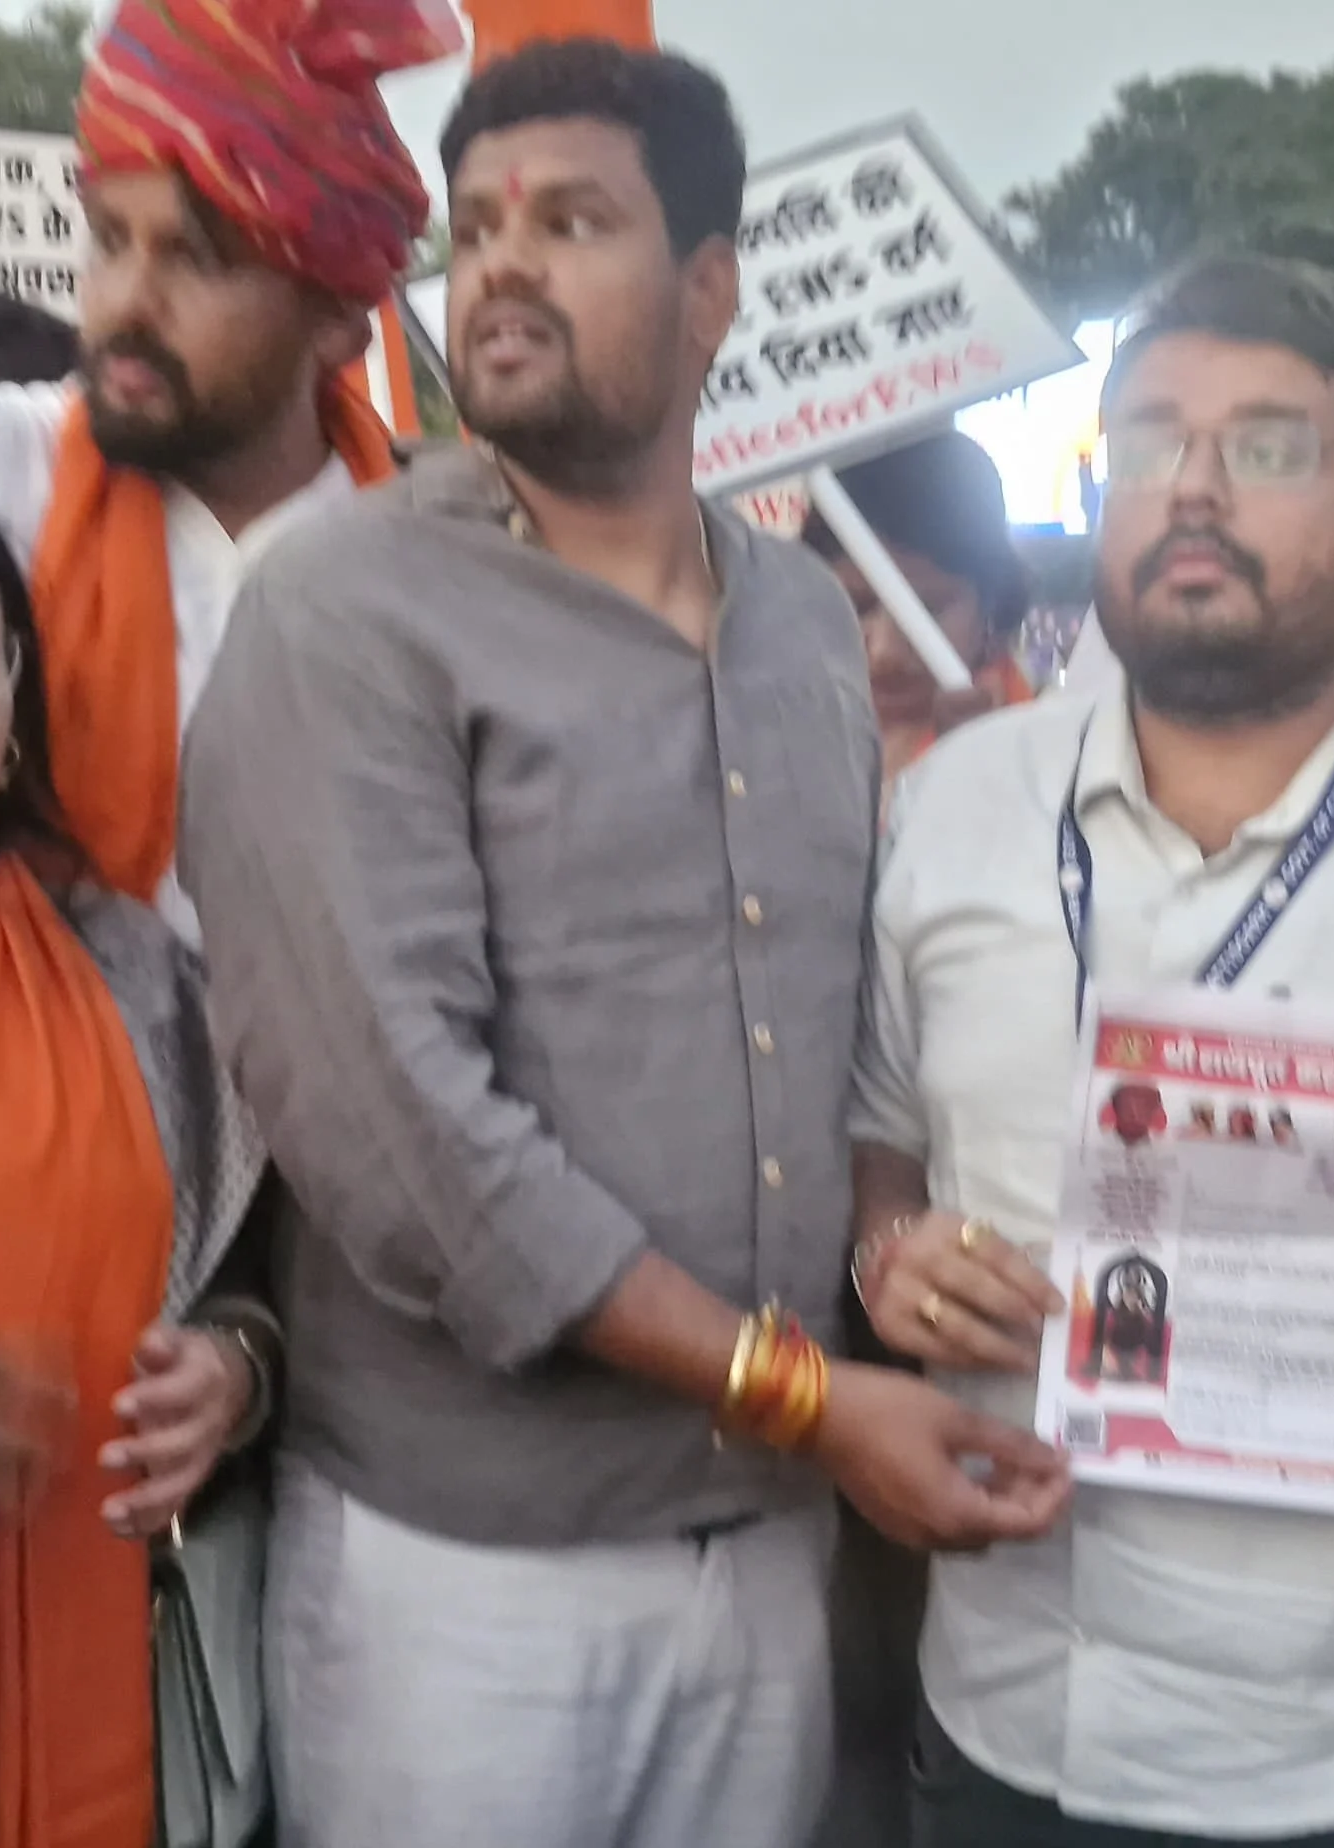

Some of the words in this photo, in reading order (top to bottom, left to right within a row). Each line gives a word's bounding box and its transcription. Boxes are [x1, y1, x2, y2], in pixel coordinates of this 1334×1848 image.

[760, 252, 869, 317] EWS
[760, 321, 870, 389] दिया
[693, 340, 1004, 475] sticeforEWS
